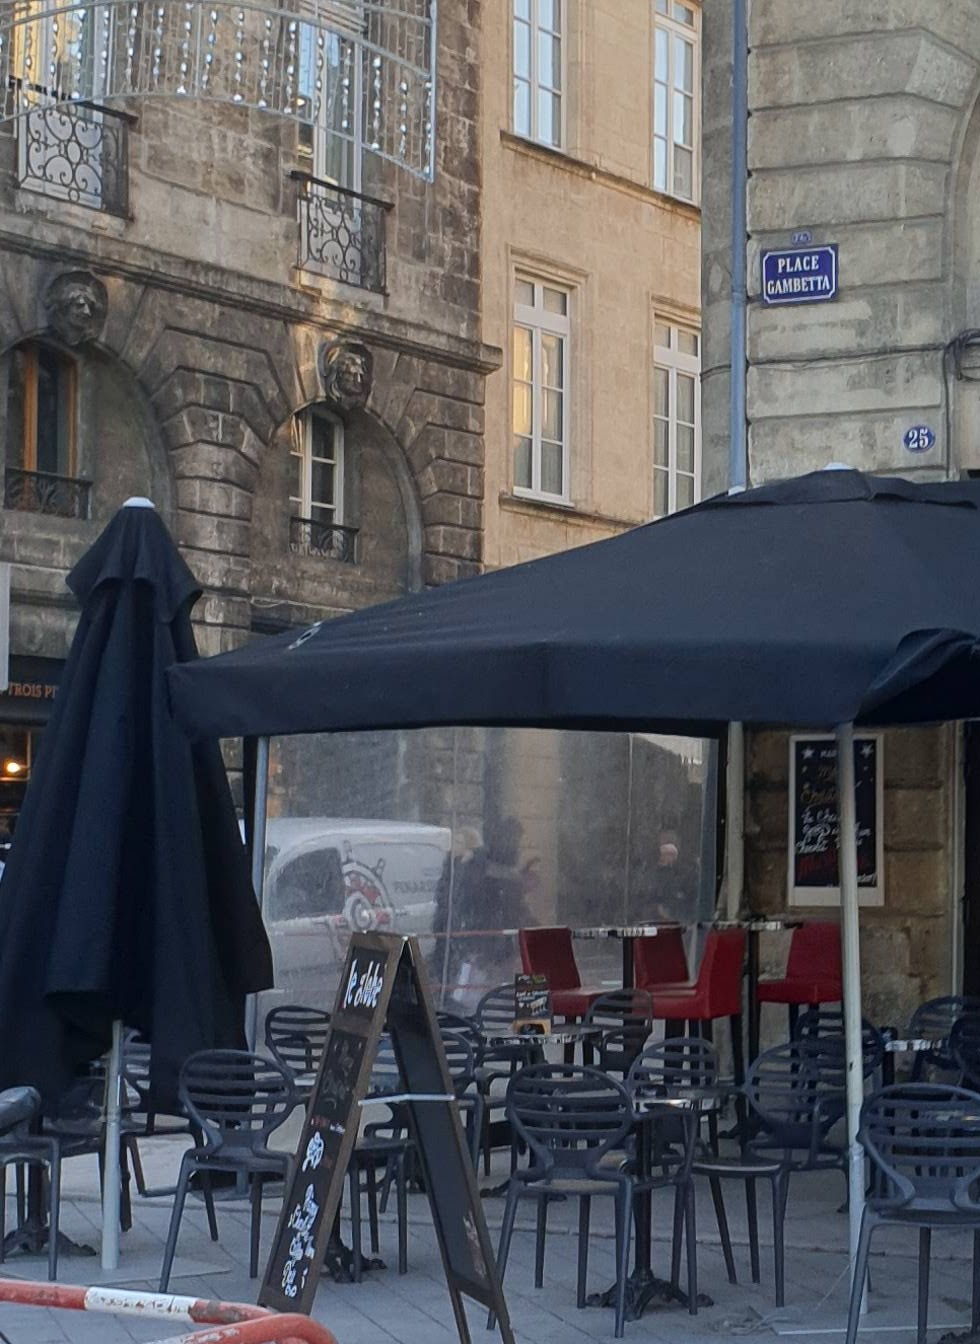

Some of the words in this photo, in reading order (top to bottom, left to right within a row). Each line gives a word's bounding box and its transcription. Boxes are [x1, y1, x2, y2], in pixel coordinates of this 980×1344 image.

[777, 255, 820, 273] PLACE
[767, 275, 831, 295] GAMBETTA
[908, 429, 929, 449] 25
